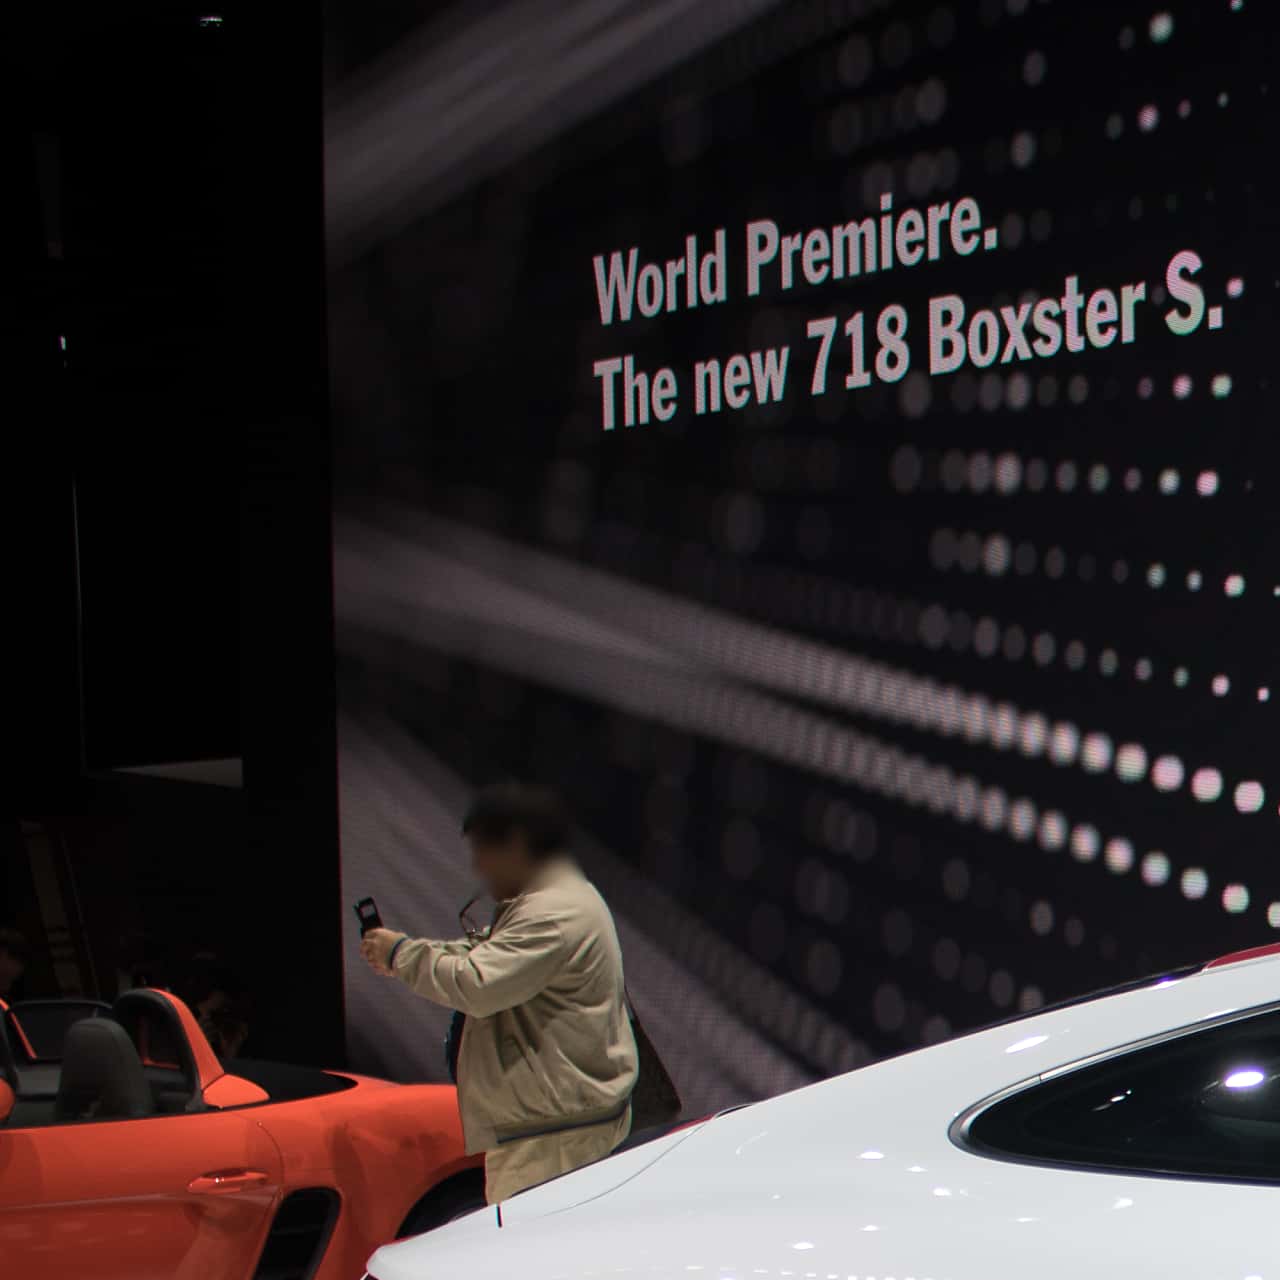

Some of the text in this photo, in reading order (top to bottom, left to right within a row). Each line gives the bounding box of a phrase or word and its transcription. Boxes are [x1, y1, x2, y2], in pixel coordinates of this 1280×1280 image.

[594, 193, 997, 325] World Premiere.
[594, 250, 1223, 430] The new 718 Boxster S.
